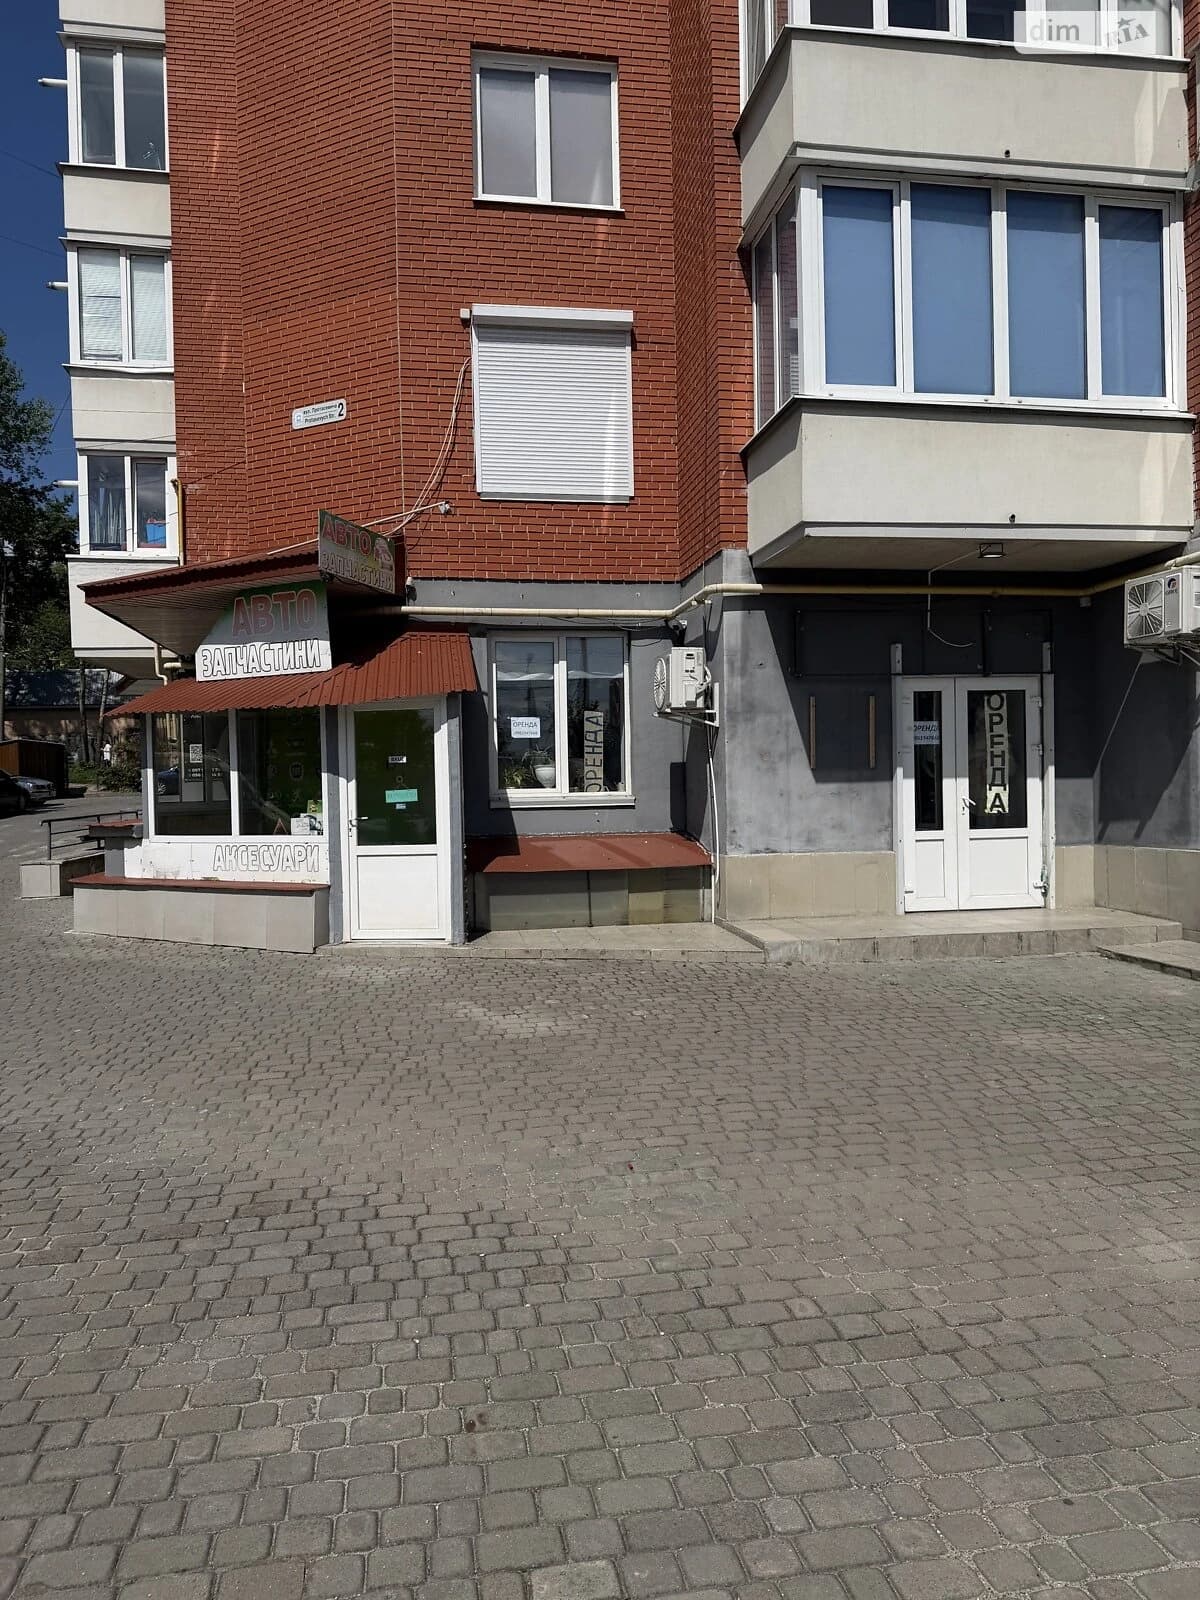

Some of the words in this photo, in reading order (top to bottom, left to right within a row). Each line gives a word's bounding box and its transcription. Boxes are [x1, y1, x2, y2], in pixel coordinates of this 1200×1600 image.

[337, 402, 344, 416] 2
[322, 515, 372, 556] АВТО
[320, 552, 395, 592] ЗАПЧАСТИНИ
[232, 589, 316, 638] АВТО
[202, 638, 321, 678] ЗАПЧАСТИНИ
[585, 714, 603, 792] ОРЕНДА
[987, 694, 1007, 813] ОРЕНДА
[213, 845, 320, 872] АКСЕСУАРИ
